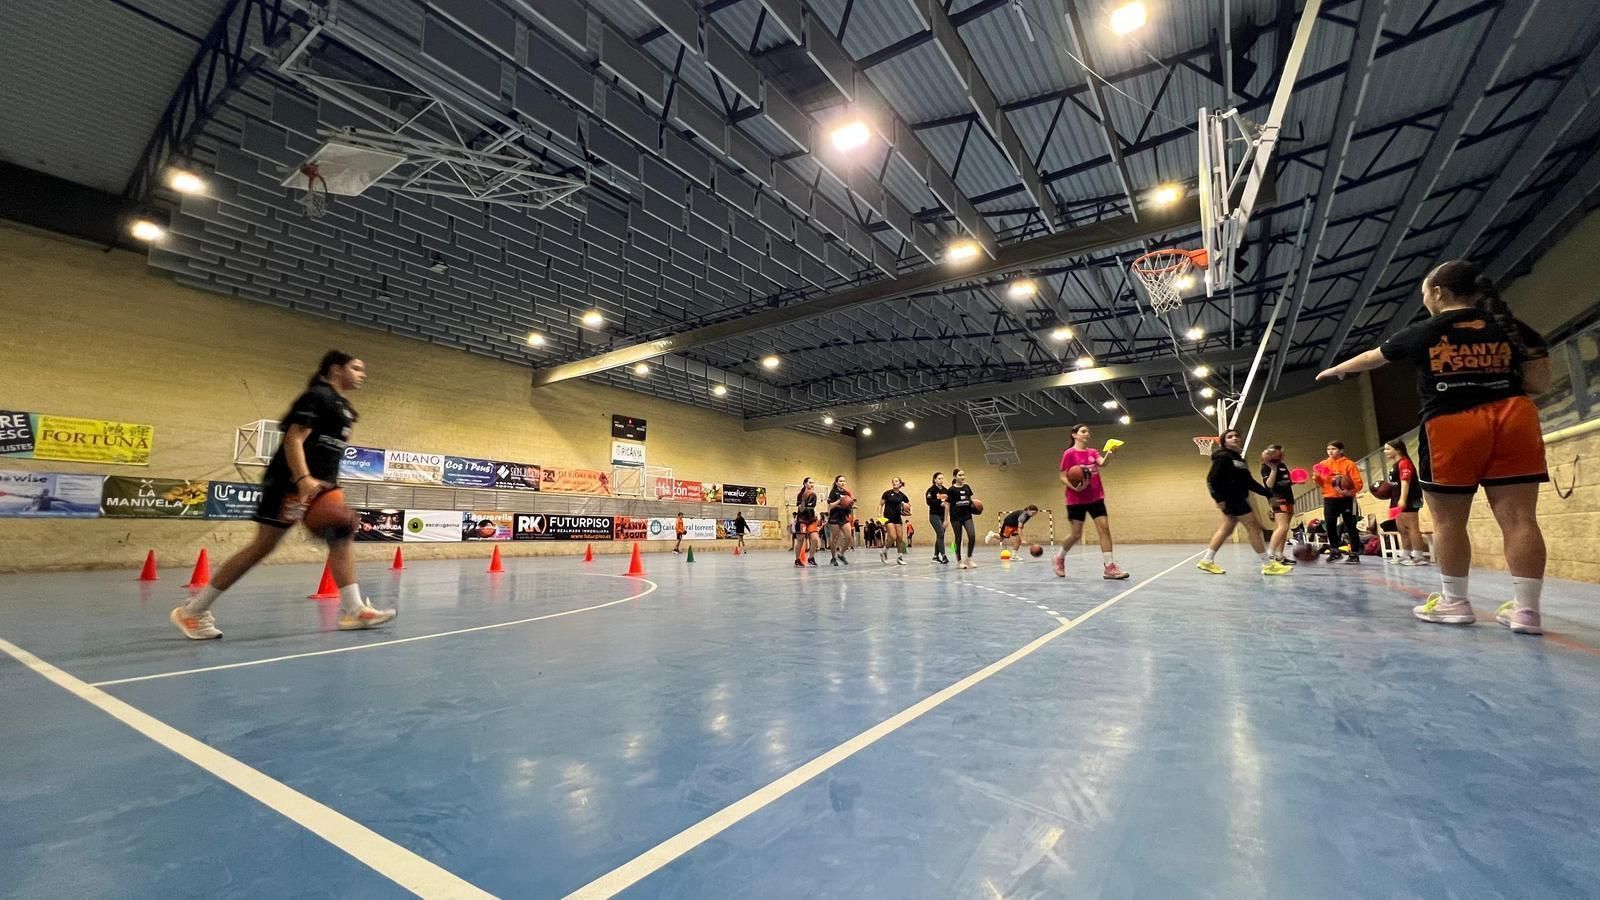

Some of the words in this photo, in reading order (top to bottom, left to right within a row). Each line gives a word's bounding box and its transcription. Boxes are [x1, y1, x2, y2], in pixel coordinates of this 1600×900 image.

[1429, 342, 1511, 358] PCANYA
[1431, 355, 1511, 372] BSQUET
[42, 430, 149, 449] FORTUNA
[0, 443, 33, 452] LISTES
[390, 453, 440, 465] MILANO
[138, 489, 155, 498] LA
[106, 498, 183, 507] MANIVELA
[518, 516, 541, 532] RK
[549, 517, 610, 528] FUTURPISO
